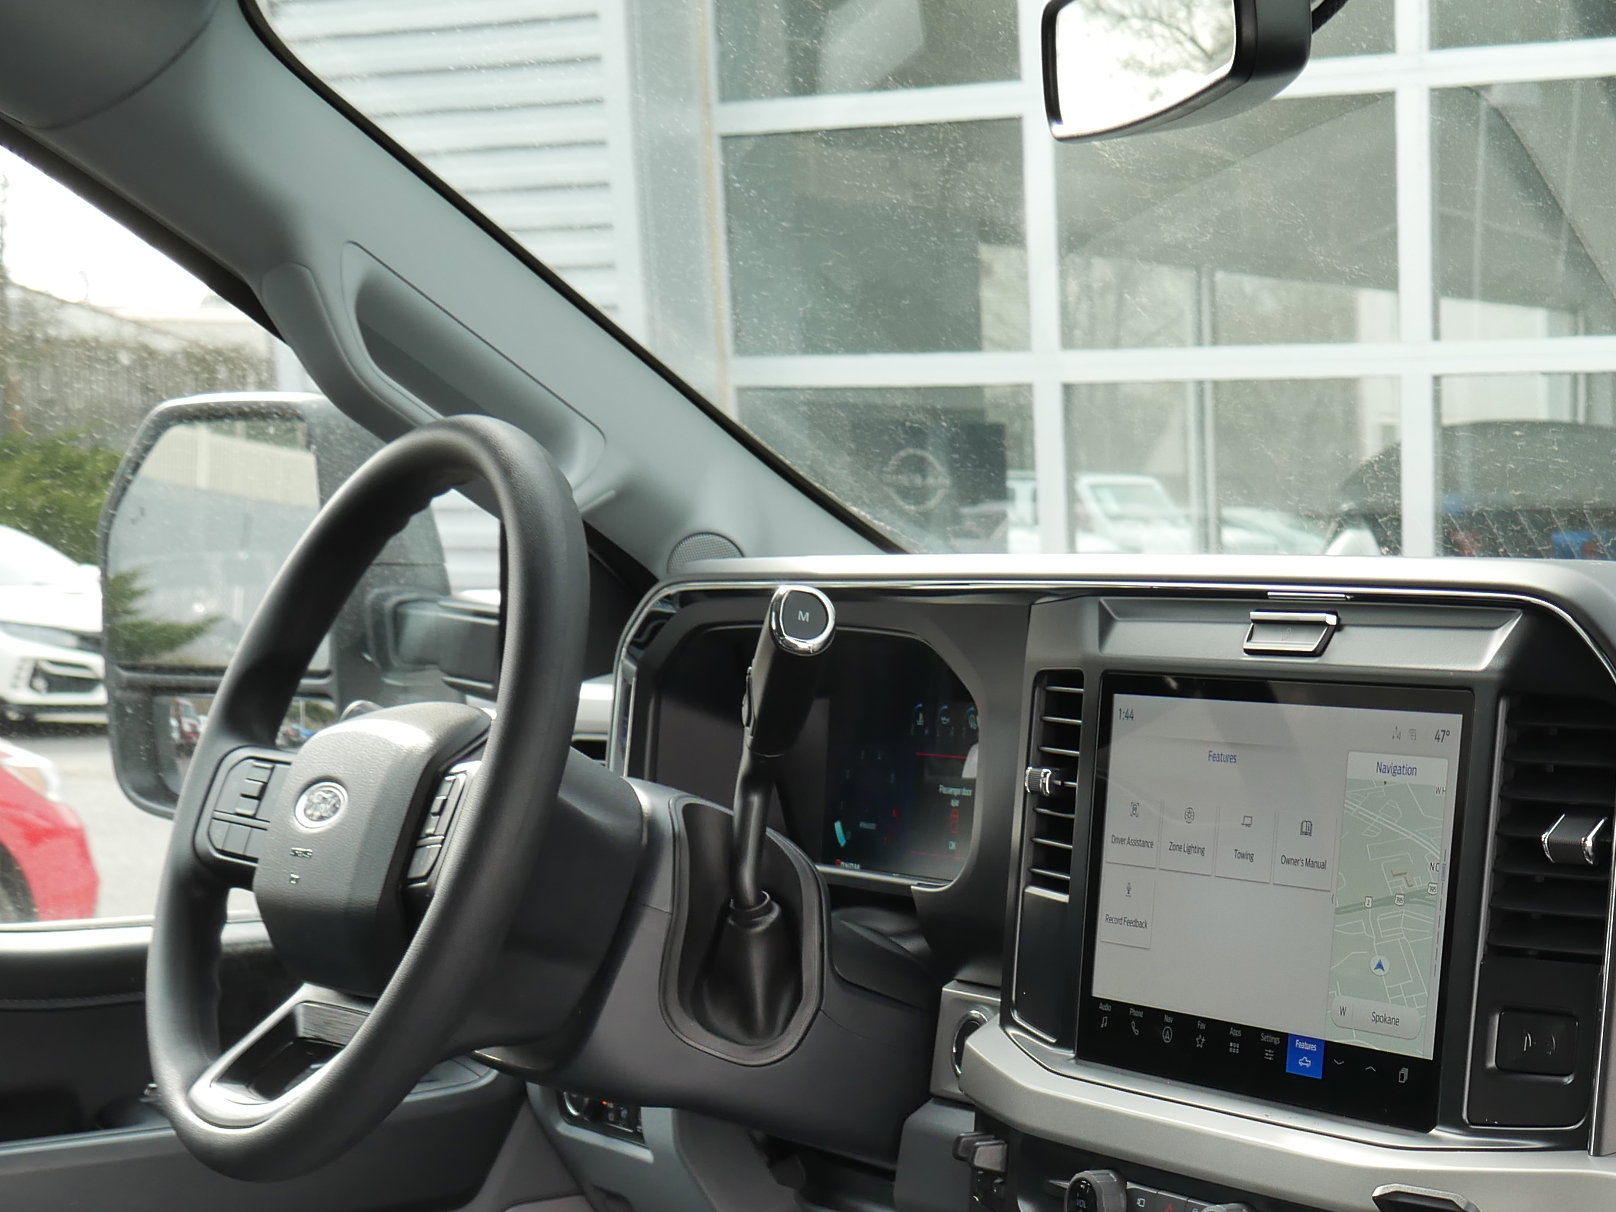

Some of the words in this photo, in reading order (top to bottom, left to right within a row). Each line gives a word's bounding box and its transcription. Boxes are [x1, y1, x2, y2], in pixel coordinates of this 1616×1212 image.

[798, 610, 810, 622] M
[1118, 708, 1134, 721] 1:44
[1434, 730, 1450, 743] 47°
[1207, 750, 1237, 764] Features
[1375, 761, 1417, 778] Navigation
[1111, 834, 1126, 846] Driver
[1126, 837, 1154, 849] Assistance
[1168, 841, 1183, 852] Zone
[1183, 843, 1206, 857] Lighting
[1234, 848, 1255, 863] Towing
[1280, 854, 1304, 868] Owner's
[1305, 857, 1328, 870] Manual
[1105, 913, 1123, 926] Record
[1123, 916, 1148, 930] Feedback
[1098, 1002, 1112, 1012] Audio
[1129, 1007, 1144, 1018] Phone
[1340, 1005, 1347, 1016] W
[1164, 1014, 1174, 1024] Nav
[1371, 1011, 1400, 1026] Spokane
[1229, 1027, 1242, 1037] Apps
[1260, 1032, 1281, 1046] Settings
[1295, 1039, 1317, 1052] Features
